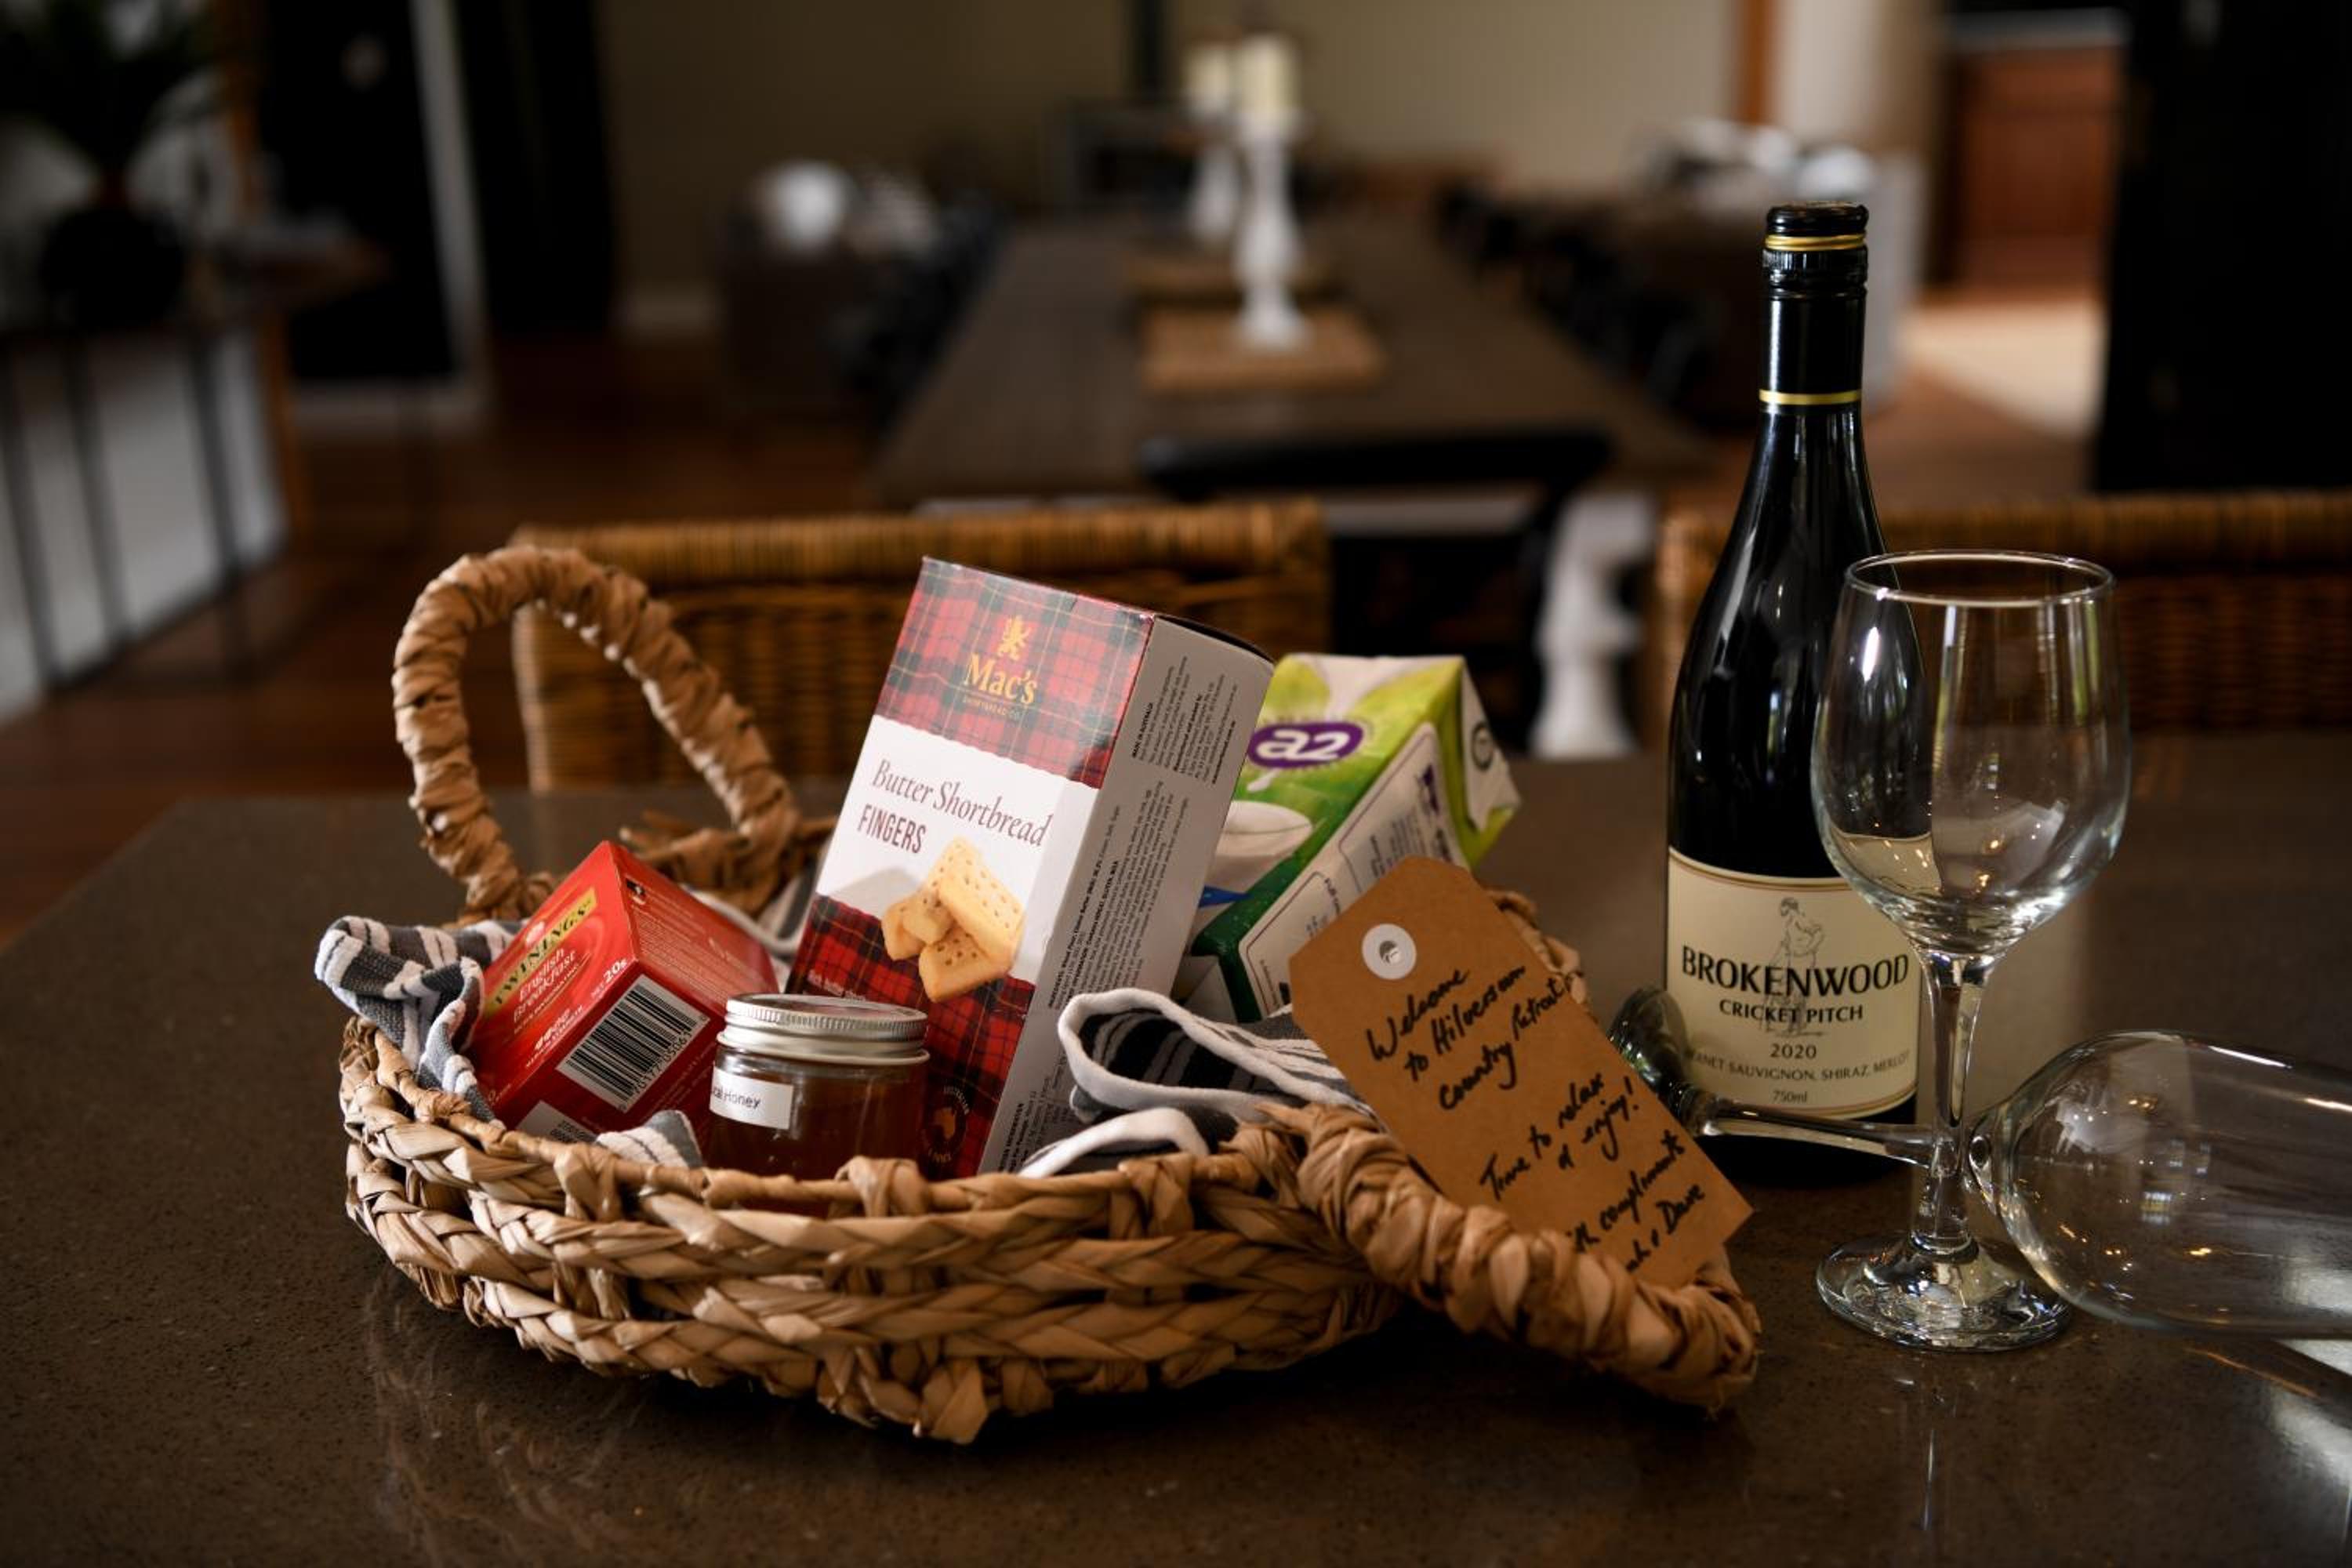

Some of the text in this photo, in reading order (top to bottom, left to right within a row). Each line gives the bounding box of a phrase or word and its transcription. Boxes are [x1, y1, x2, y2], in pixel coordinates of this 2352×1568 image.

[963, 652, 1037, 704] Mac's
[1256, 729, 1350, 760] a2
[872, 759, 933, 804] Butter
[933, 781, 1054, 846] Shortbread
[857, 804, 927, 854] FINGERS
[495, 909, 587, 1004] TWININGS
[518, 947, 566, 1002] English
[1682, 944, 1910, 997] BROKENWOOD
[513, 949, 576, 1024] Breakfast
[1719, 999, 1864, 1024] CRICKET PITCH
[1367, 969, 1470, 1061] Welcome
[1403, 1051, 1430, 1083] to
[1439, 1040, 1517, 1110] Country
[1769, 1043, 1817, 1059] 2020
[724, 1090, 761, 1110] Honey
[1581, 1075, 1639, 1162] enjoy!
[1772, 1090, 1808, 1104] 750ml
[1479, 1072, 1605, 1202] Time to relax
[1655, 1183, 1706, 1235] Dave
